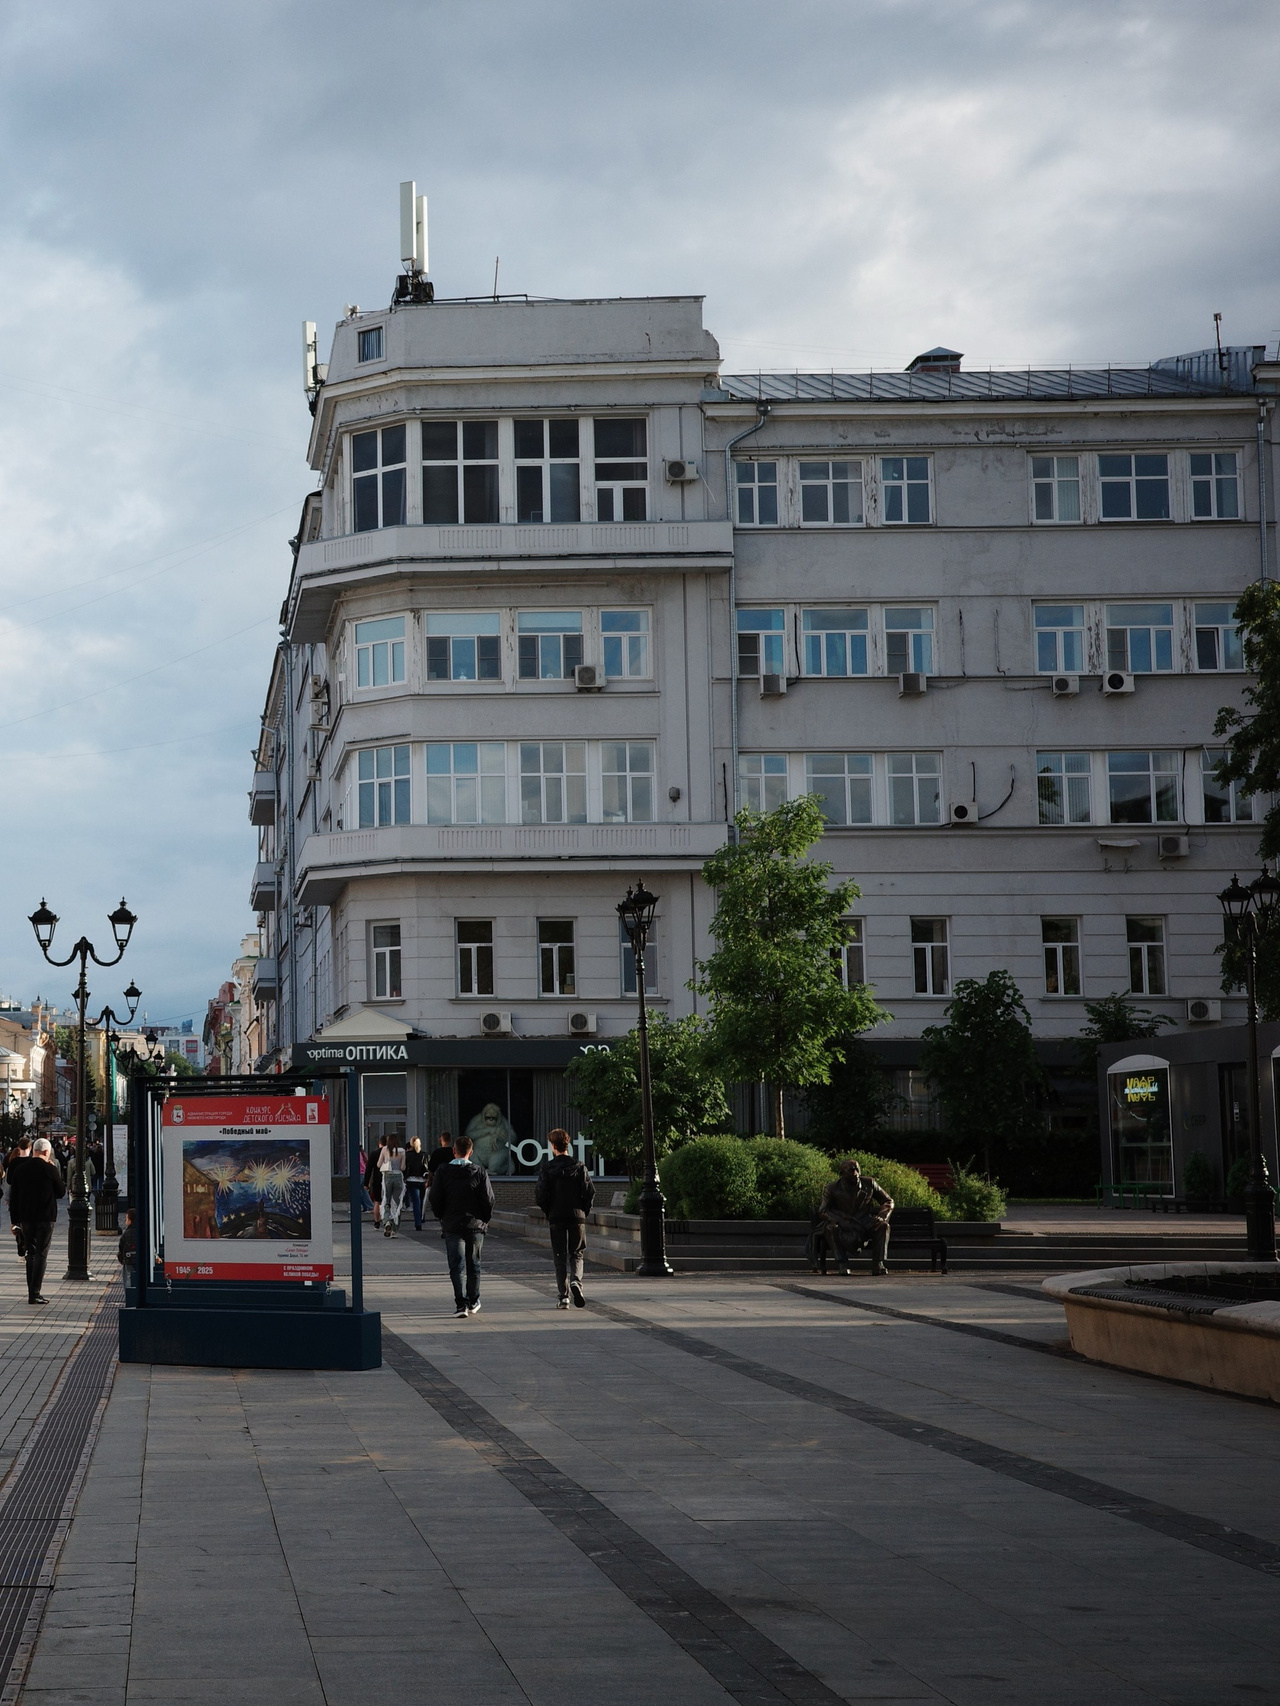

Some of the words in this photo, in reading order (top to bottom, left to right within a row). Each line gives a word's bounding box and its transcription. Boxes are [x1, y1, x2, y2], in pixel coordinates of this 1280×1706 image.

[307, 1046, 344, 1061] optima
[345, 1045, 409, 1061] ОПТИКА
[245, 1106, 271, 1114] КОНКУРС
[242, 1114, 274, 1123] ДЕТСКОГО
[275, 1114, 301, 1122] РИСУНКА
[175, 1266, 191, 1274] 1945
[197, 1266, 214, 1275] 2025
